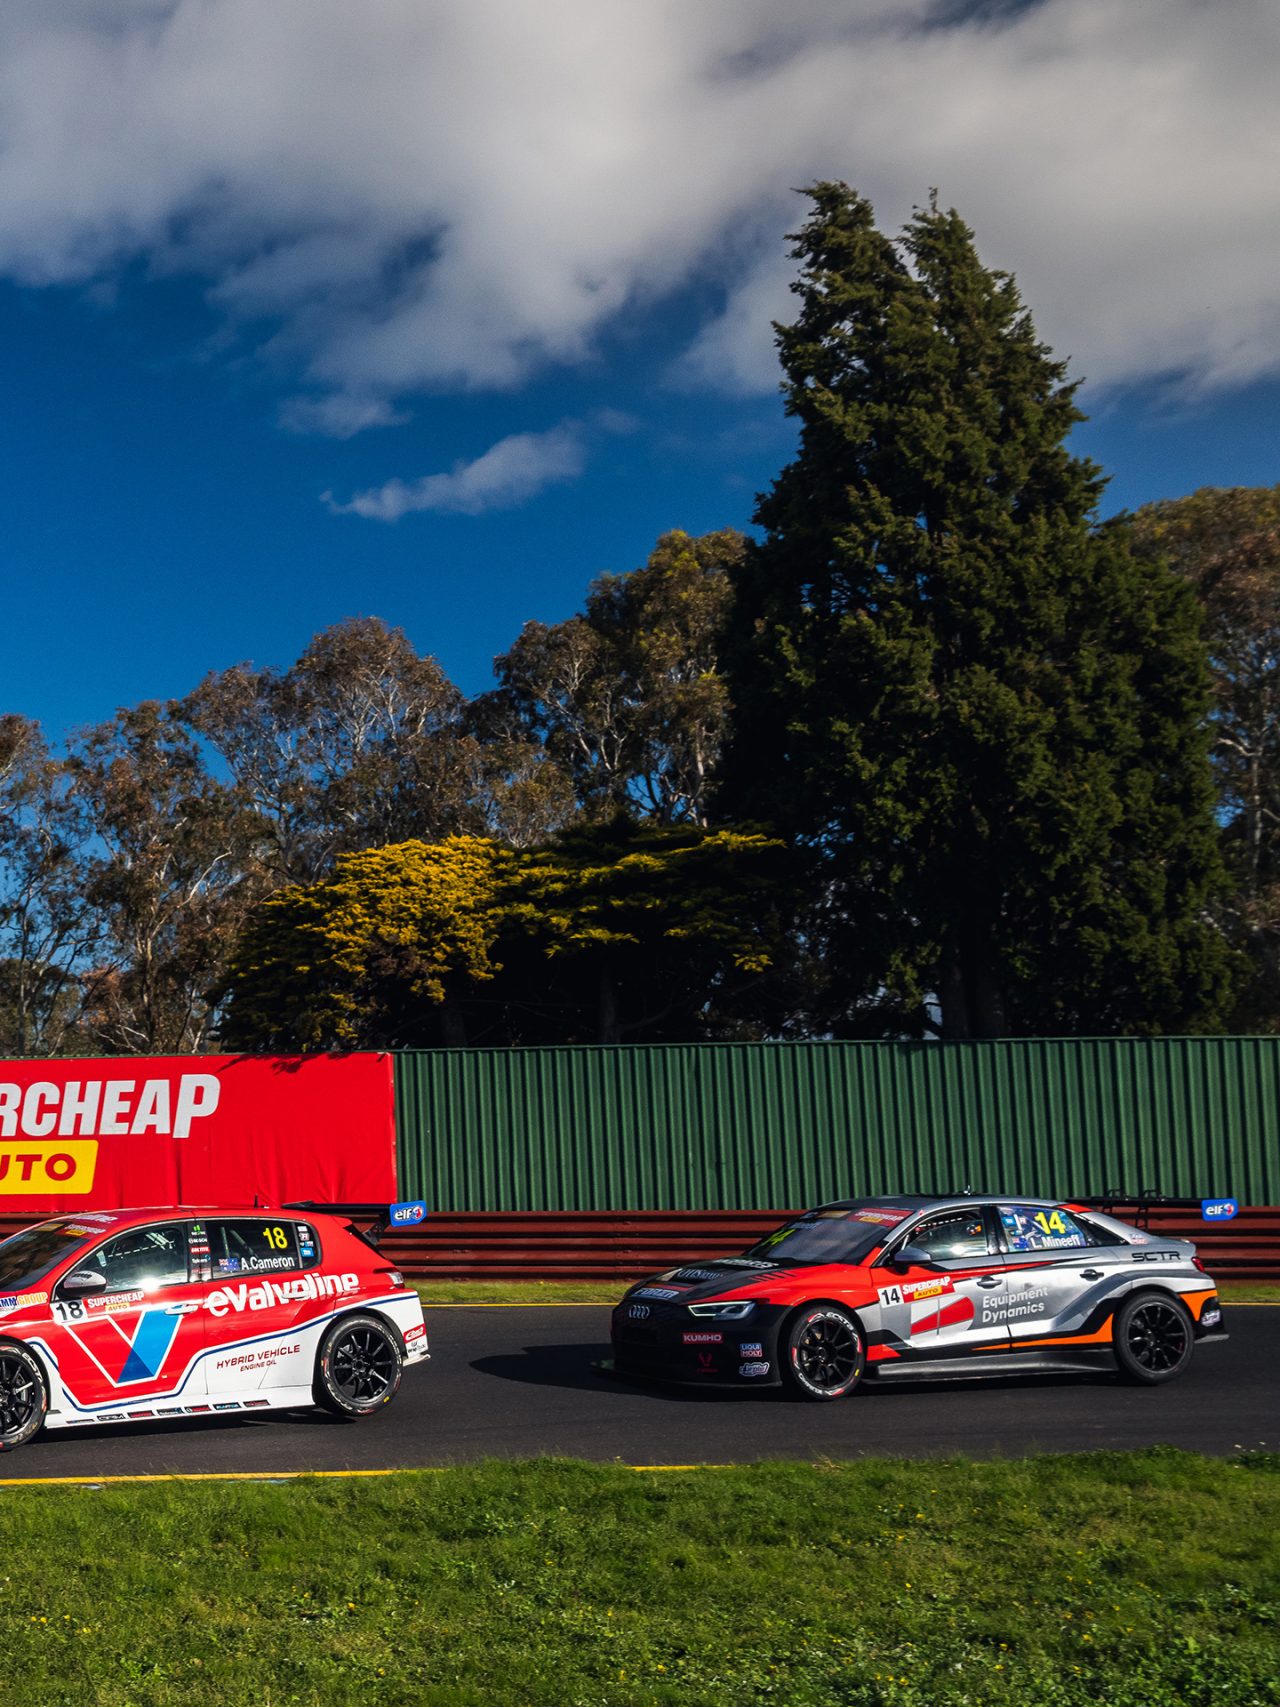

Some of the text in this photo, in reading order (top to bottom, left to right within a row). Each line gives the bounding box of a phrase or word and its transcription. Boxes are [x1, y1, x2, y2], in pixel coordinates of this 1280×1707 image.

[394, 1208, 412, 1220] elf
[1206, 1204, 1224, 1215] elf
[1034, 1211, 1066, 1235] 14
[262, 1226, 288, 1249] 18
[1042, 1234, 1081, 1248] Mineeff
[1131, 1251, 1181, 1262] SCTR
[902, 1276, 951, 1295] SUPERCHEAP
[917, 1288, 939, 1297] AUTO
[17, 1291, 49, 1306] GROUP
[87, 1291, 145, 1308] SUPERCHEAP
[206, 1272, 360, 1317] eValvoline
[881, 1288, 901, 1305] 14
[982, 1286, 1049, 1309] Equipment
[55, 1301, 84, 1321] 18
[982, 1302, 1045, 1323] Dynamics
[683, 1334, 722, 1342] KUMHO
[217, 1344, 301, 1370] HYBRID VEHICLE
[240, 1361, 265, 1372] ENGINE
